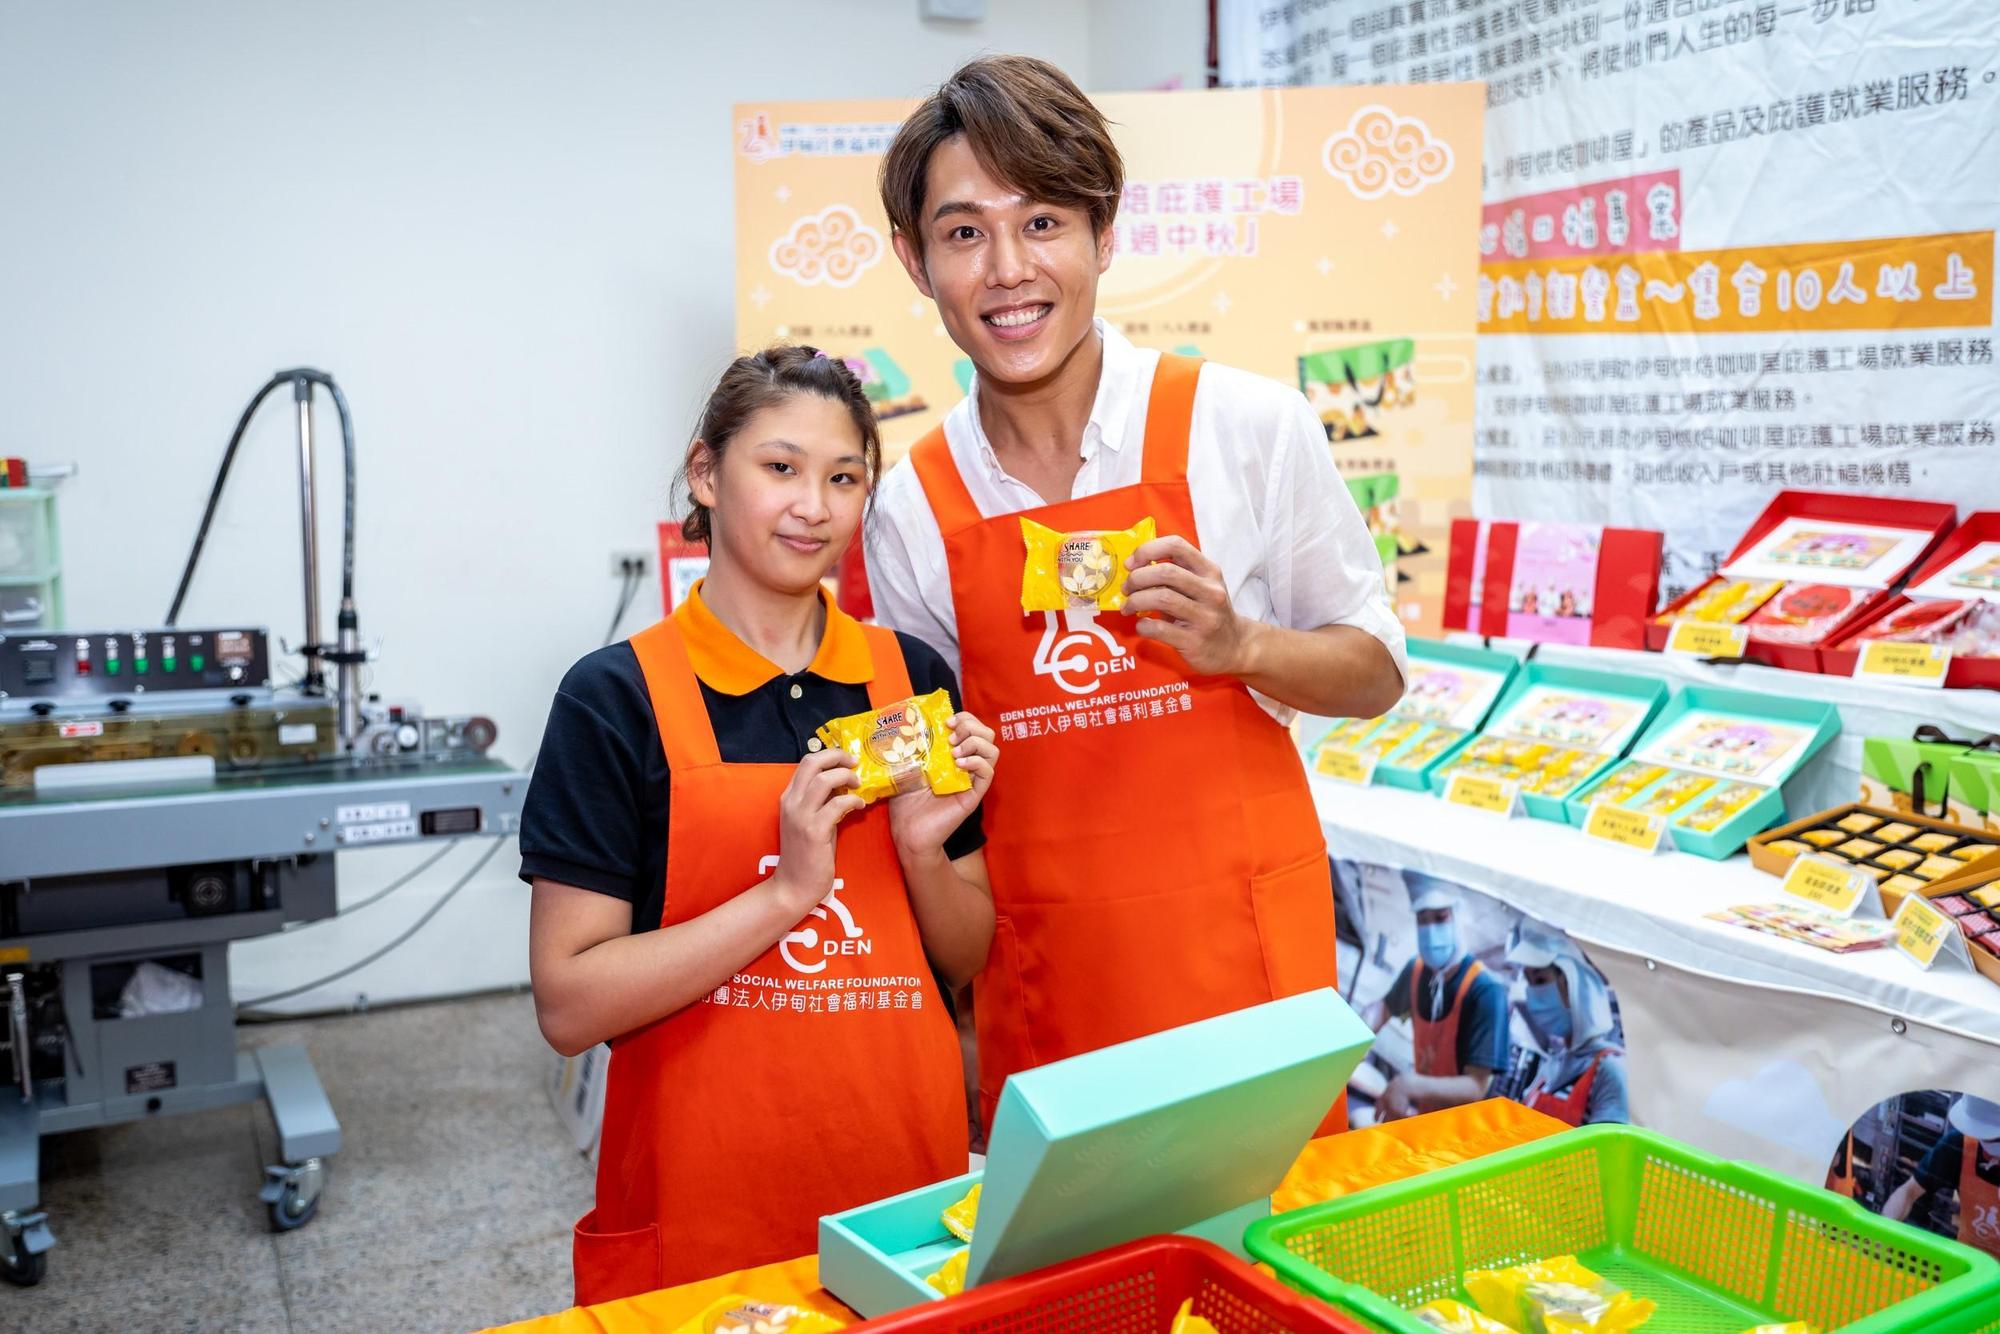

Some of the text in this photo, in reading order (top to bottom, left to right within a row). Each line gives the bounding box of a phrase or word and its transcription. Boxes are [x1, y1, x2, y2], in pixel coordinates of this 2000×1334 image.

[1064, 542, 1090, 552] SHARE
[1000, 681, 1189, 723] EDEN SOCIAL WELFARE FOUNDATION
[877, 712, 902, 729] SHARE
[1001, 694, 1192, 741] 財團法人伊甸社會福利基金會
[733, 974, 922, 990] SOCIAL WELFARE FOUNDATION
